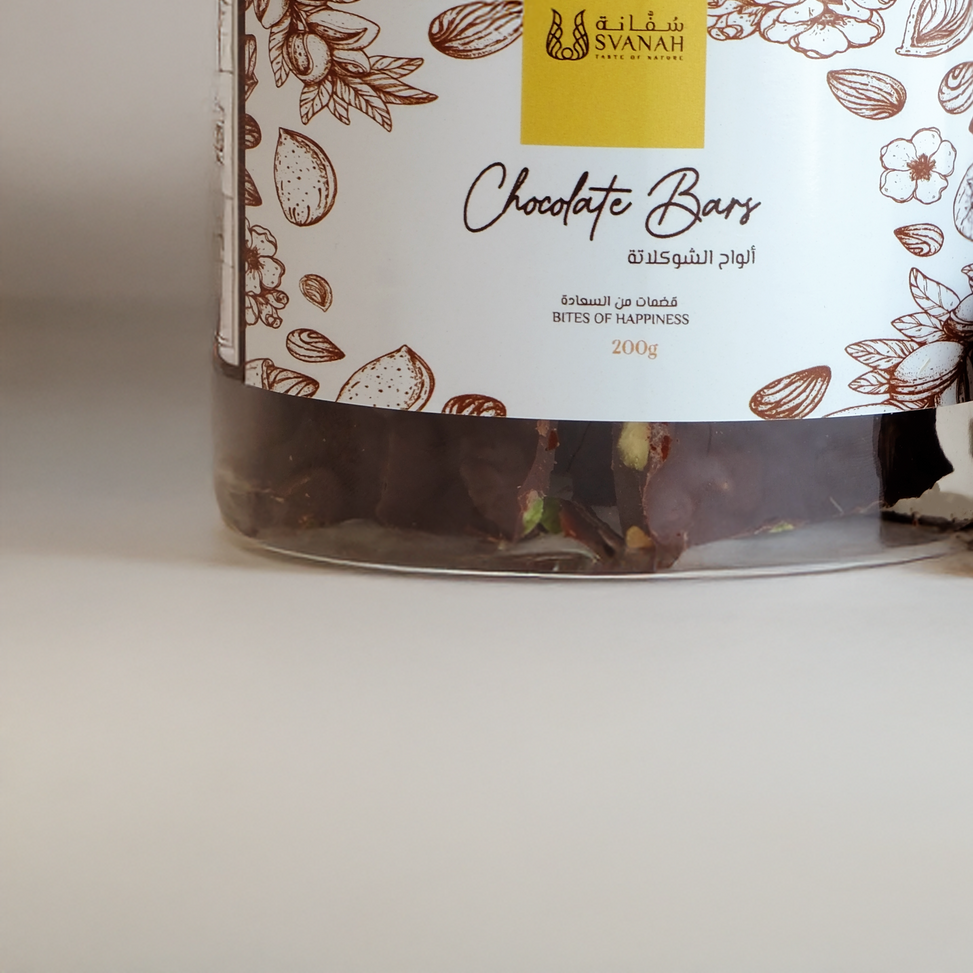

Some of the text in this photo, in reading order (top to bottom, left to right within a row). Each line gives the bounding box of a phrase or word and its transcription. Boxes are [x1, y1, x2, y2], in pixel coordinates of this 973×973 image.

[594, 33, 684, 52] SVANAH
[463, 161, 762, 241] Chocolate Bars
[627, 244, 756, 270] ألواح الشوكلاتة
[561, 294, 678, 310] قضمات من السعادة
[552, 311, 690, 325] BITES OF HAPPINESS
[611, 339, 658, 360] 200g
